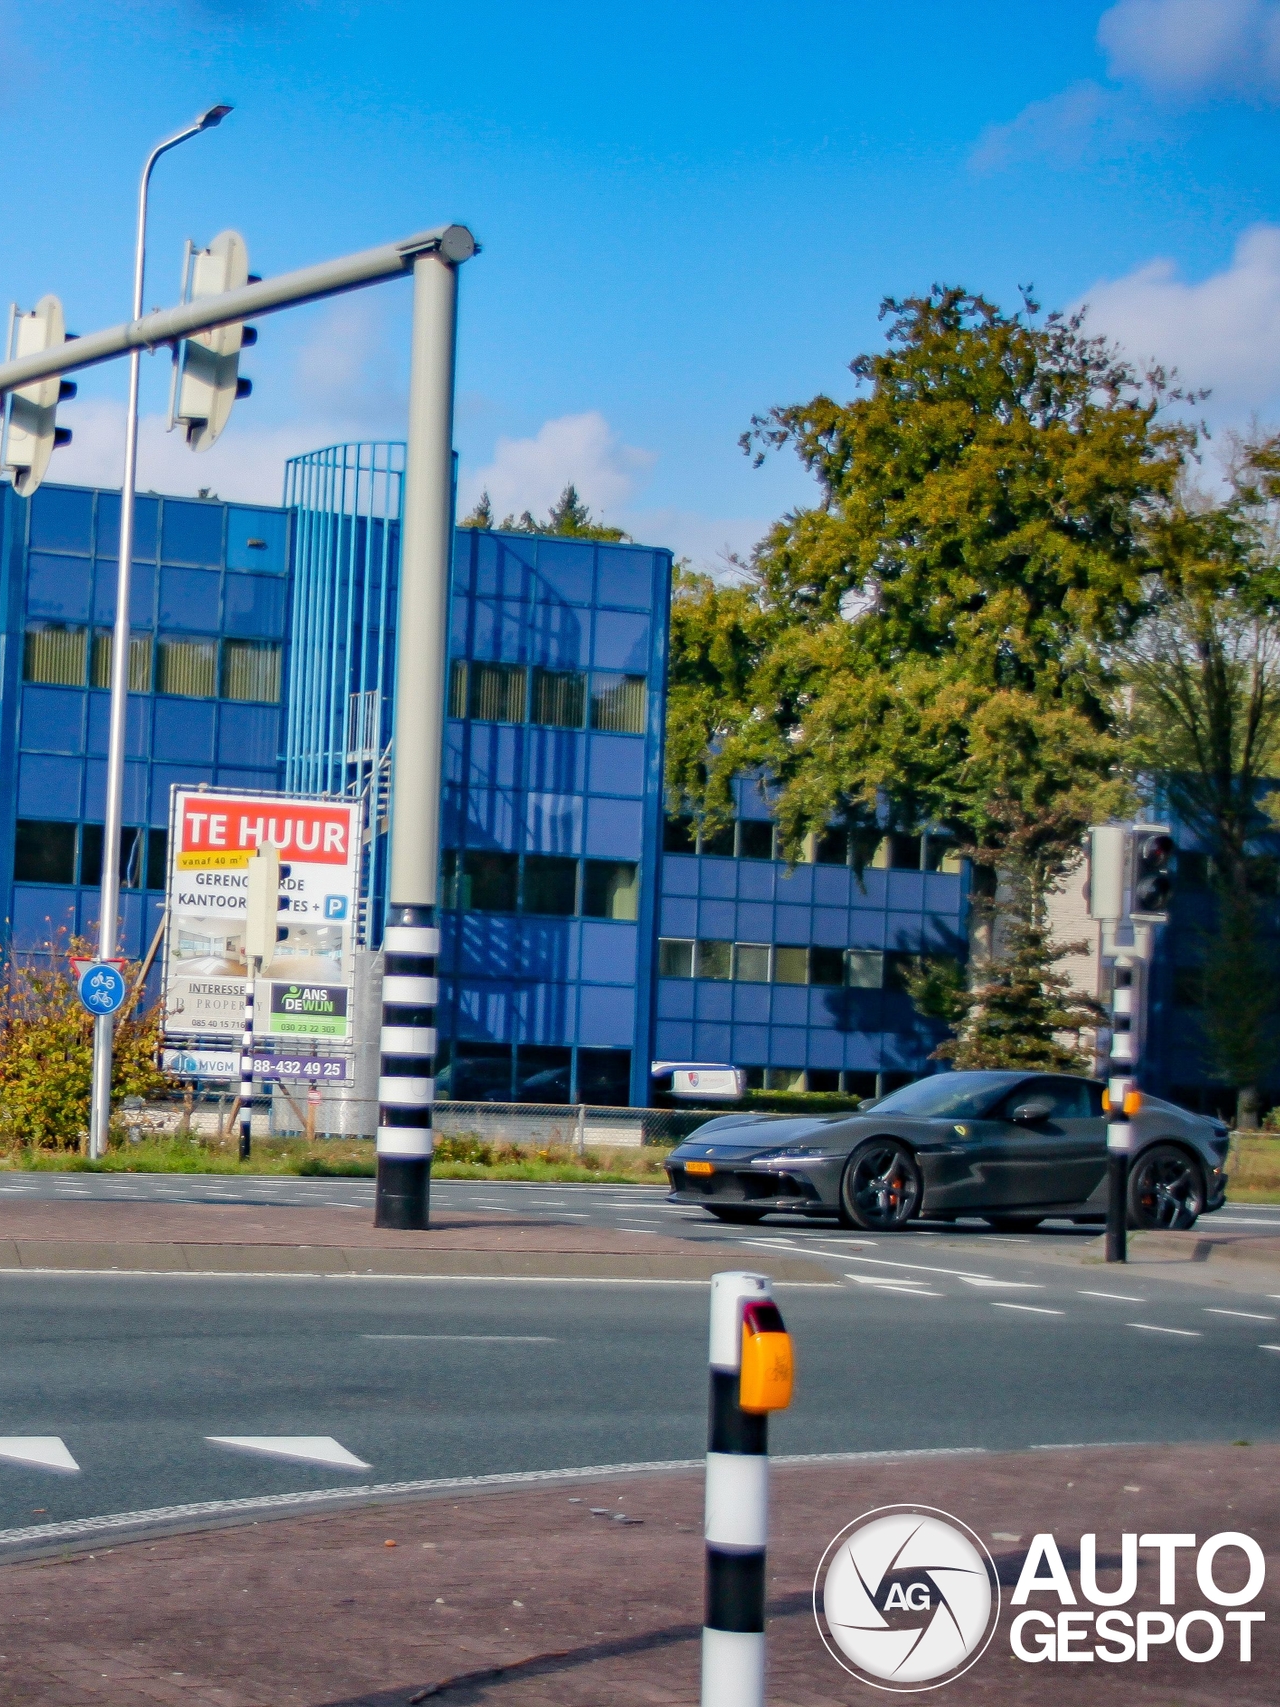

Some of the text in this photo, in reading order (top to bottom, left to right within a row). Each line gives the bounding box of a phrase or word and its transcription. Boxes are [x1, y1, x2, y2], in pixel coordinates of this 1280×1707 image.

[186, 812, 346, 853] TE HUUR
[182, 857, 211, 865] vanaf
[214, 857, 226, 865] 40
[195, 873, 304, 891] GERENORDE
[189, 983, 245, 995] INTERESSE
[196, 999, 263, 1011] PROPERY
[192, 1019, 205, 1027] 085
[220, 1020, 229, 1028] 15
[281, 1023, 335, 1033] 030 23 22 303
[199, 1060, 234, 1072] MVGM
[253, 1060, 341, 1076] 88-432 49 25
